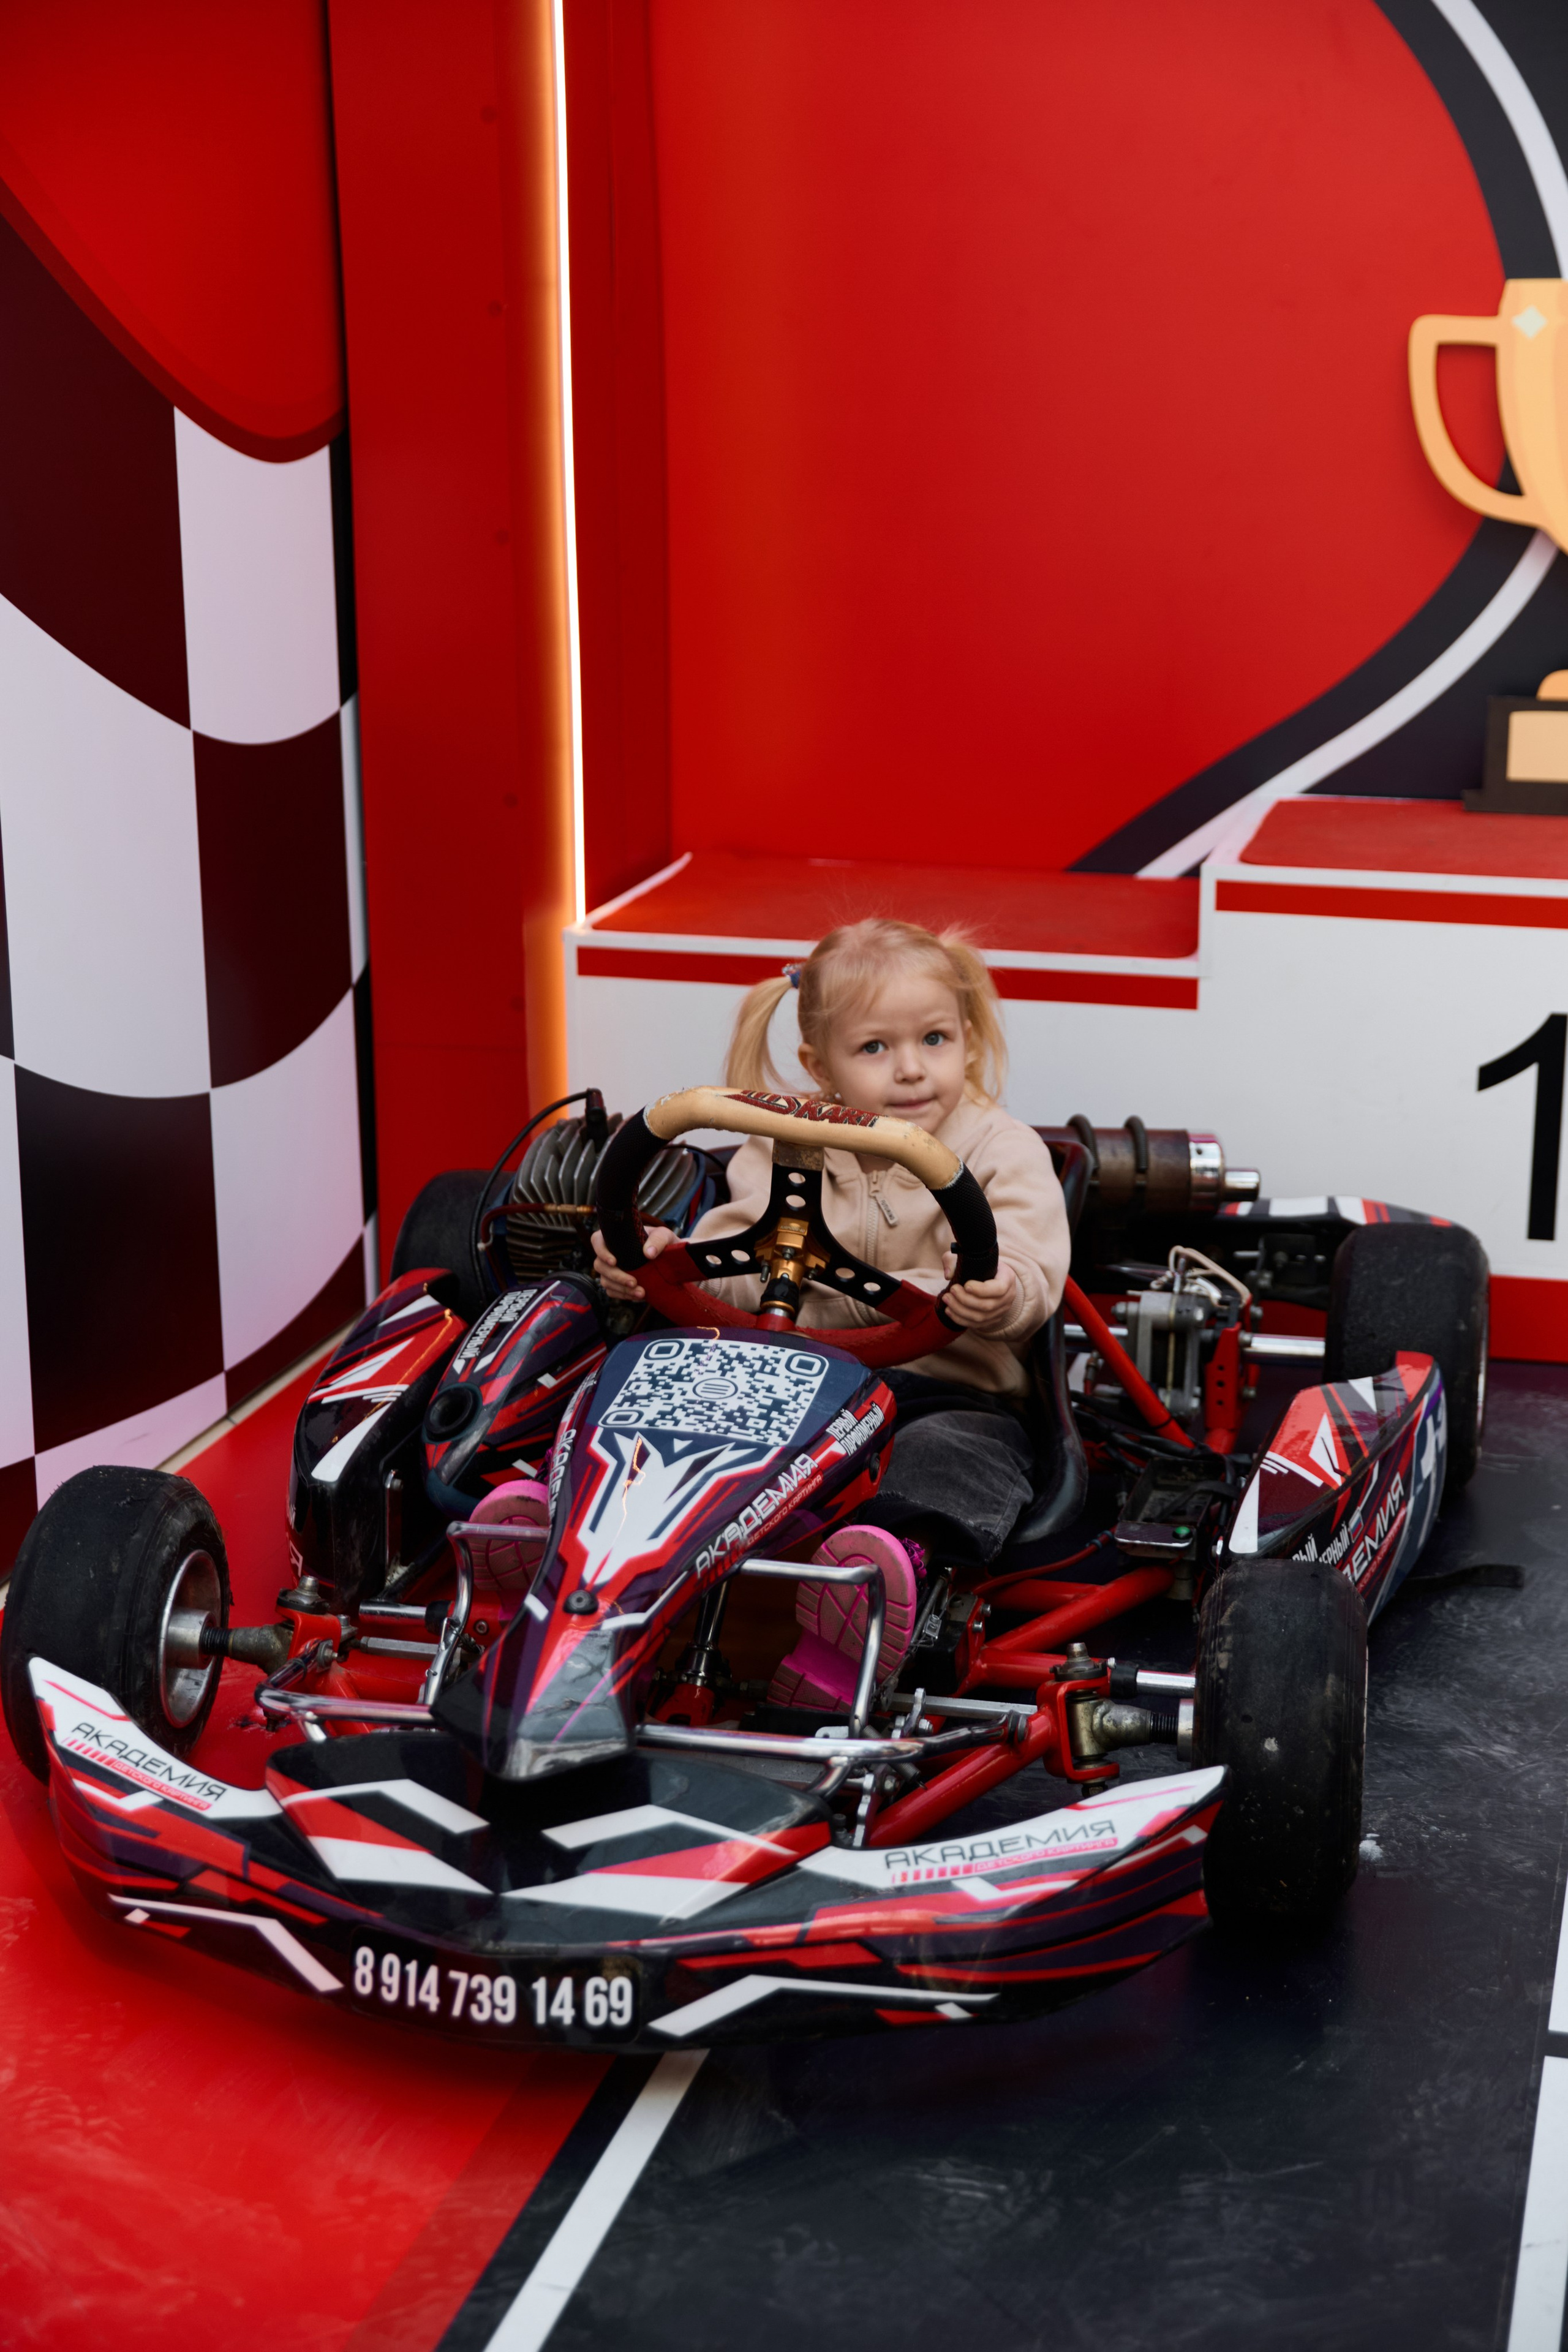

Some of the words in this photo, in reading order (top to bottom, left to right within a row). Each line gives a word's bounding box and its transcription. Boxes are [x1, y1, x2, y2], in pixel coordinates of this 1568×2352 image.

[1477, 1012, 1568, 1241] 1
[825, 1408, 858, 1441] ПЕРВЫЙ
[696, 1453, 819, 1579] АКАДЕМИЯ
[747, 1508, 788, 1547] ДЕТСКОГО
[788, 1474, 823, 1510] КАРТИНГА
[71, 1722, 227, 1801] АКАДЕМИЯ
[114, 1760, 160, 1789] ДЕТСКОГО
[885, 1820, 1116, 1869] АКАДЕМИЯ
[976, 1850, 1046, 1872] ДЕТСКОГО
[1047, 1839, 1115, 1856] КАРТИНГА
[354, 1946, 375, 1995] 8
[381, 1953, 440, 2012] 914
[448, 1970, 516, 2023] 739
[531, 1976, 575, 2026] 14
[584, 1975, 633, 2026] 69
